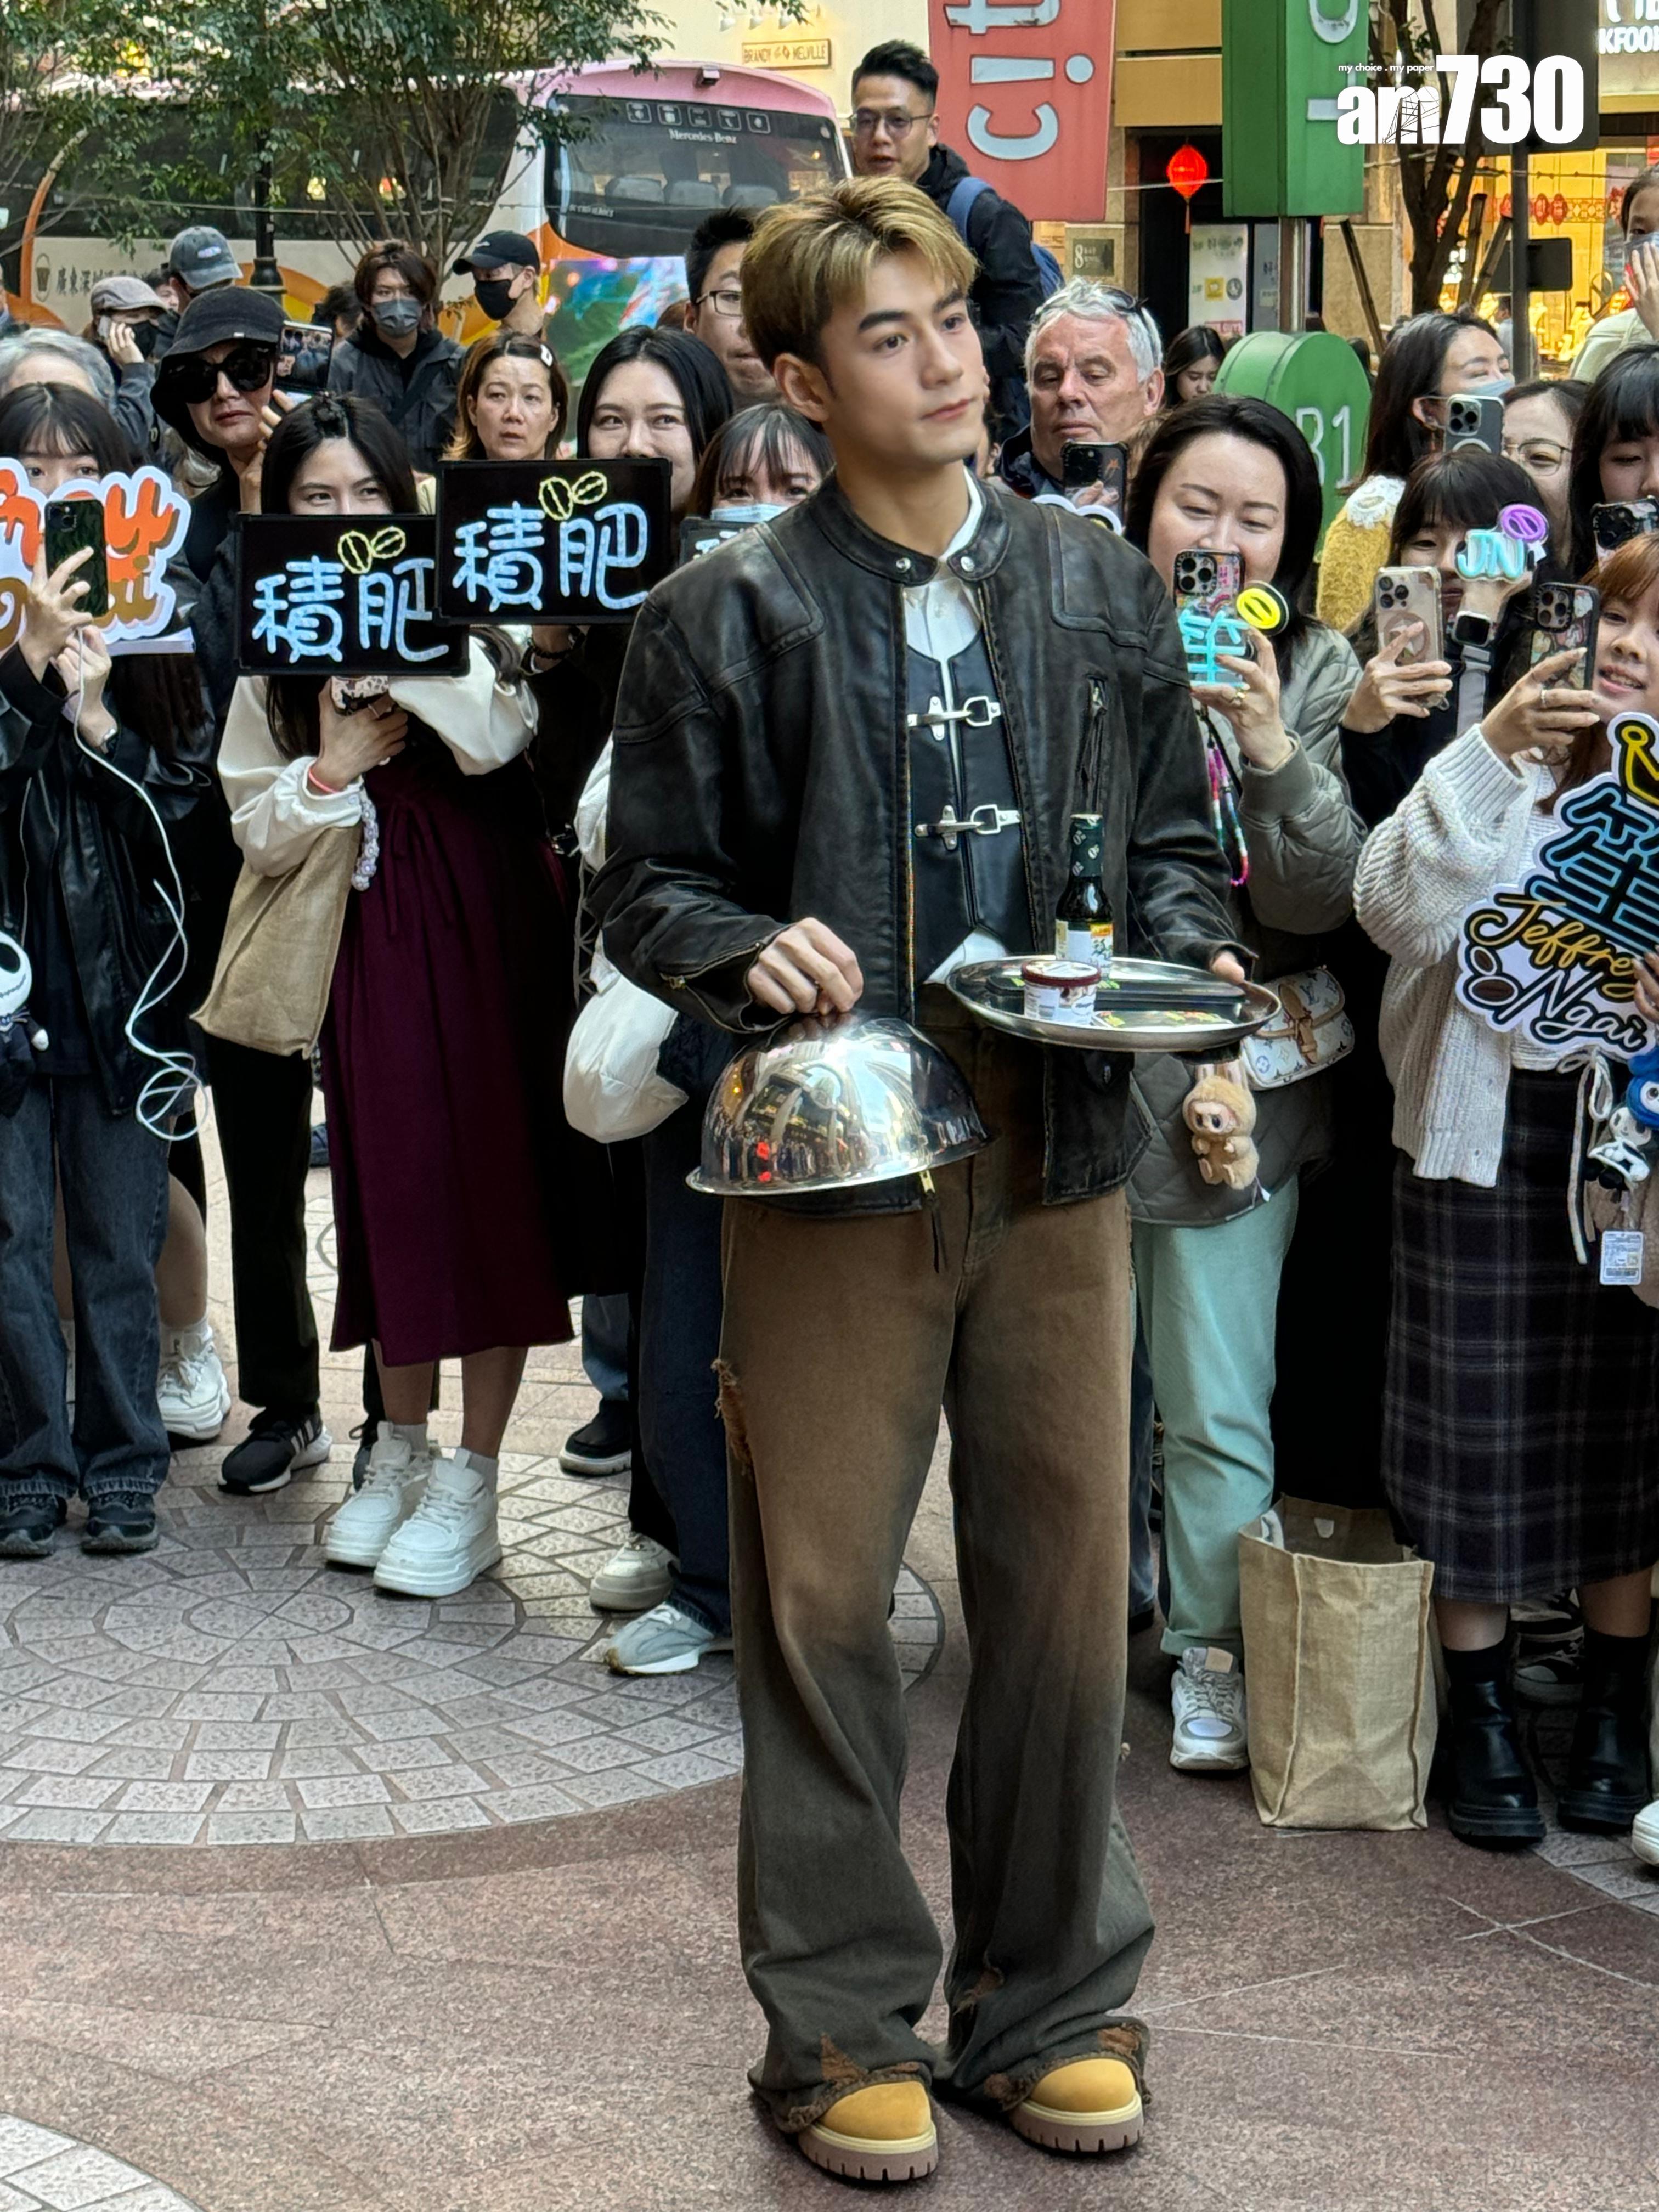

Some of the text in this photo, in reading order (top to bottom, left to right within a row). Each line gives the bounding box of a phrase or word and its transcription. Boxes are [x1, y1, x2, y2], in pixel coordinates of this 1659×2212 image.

[251, 554, 449, 664] 積肥
[453, 500, 650, 612] 積肥
[1496, 964, 1644, 1049] Ngai
